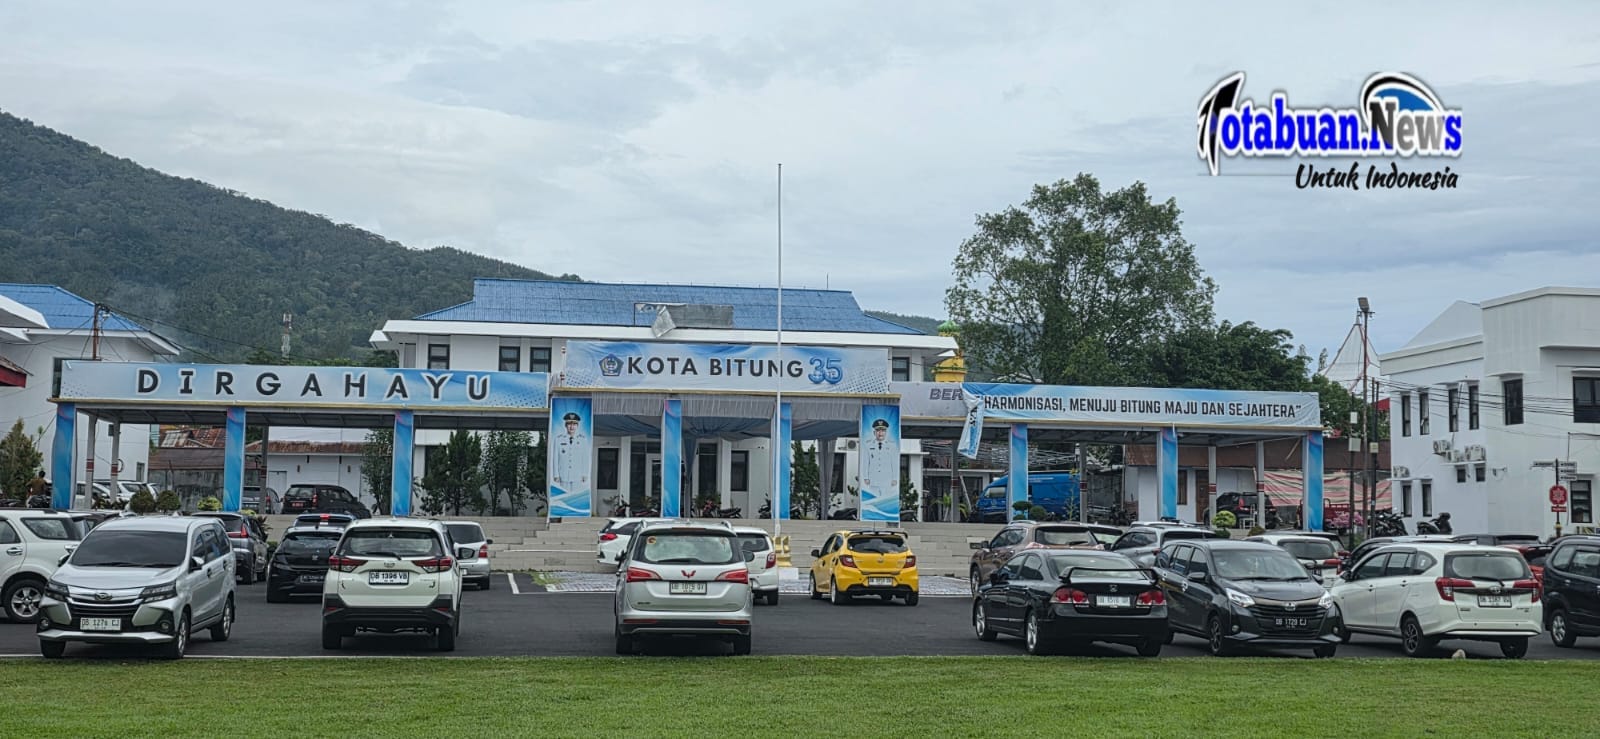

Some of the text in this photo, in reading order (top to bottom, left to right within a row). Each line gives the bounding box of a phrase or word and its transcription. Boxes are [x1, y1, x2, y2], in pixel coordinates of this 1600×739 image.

[137, 369, 488, 400] DIRGAHAYU
[627, 356, 843, 385] KOTA BITUNG 35
[1069, 398, 1117, 413] MENUJU
[1120, 399, 1161, 414] BITUNG
[1164, 401, 1198, 415] MAJU
[1201, 402, 1225, 416] DAN
